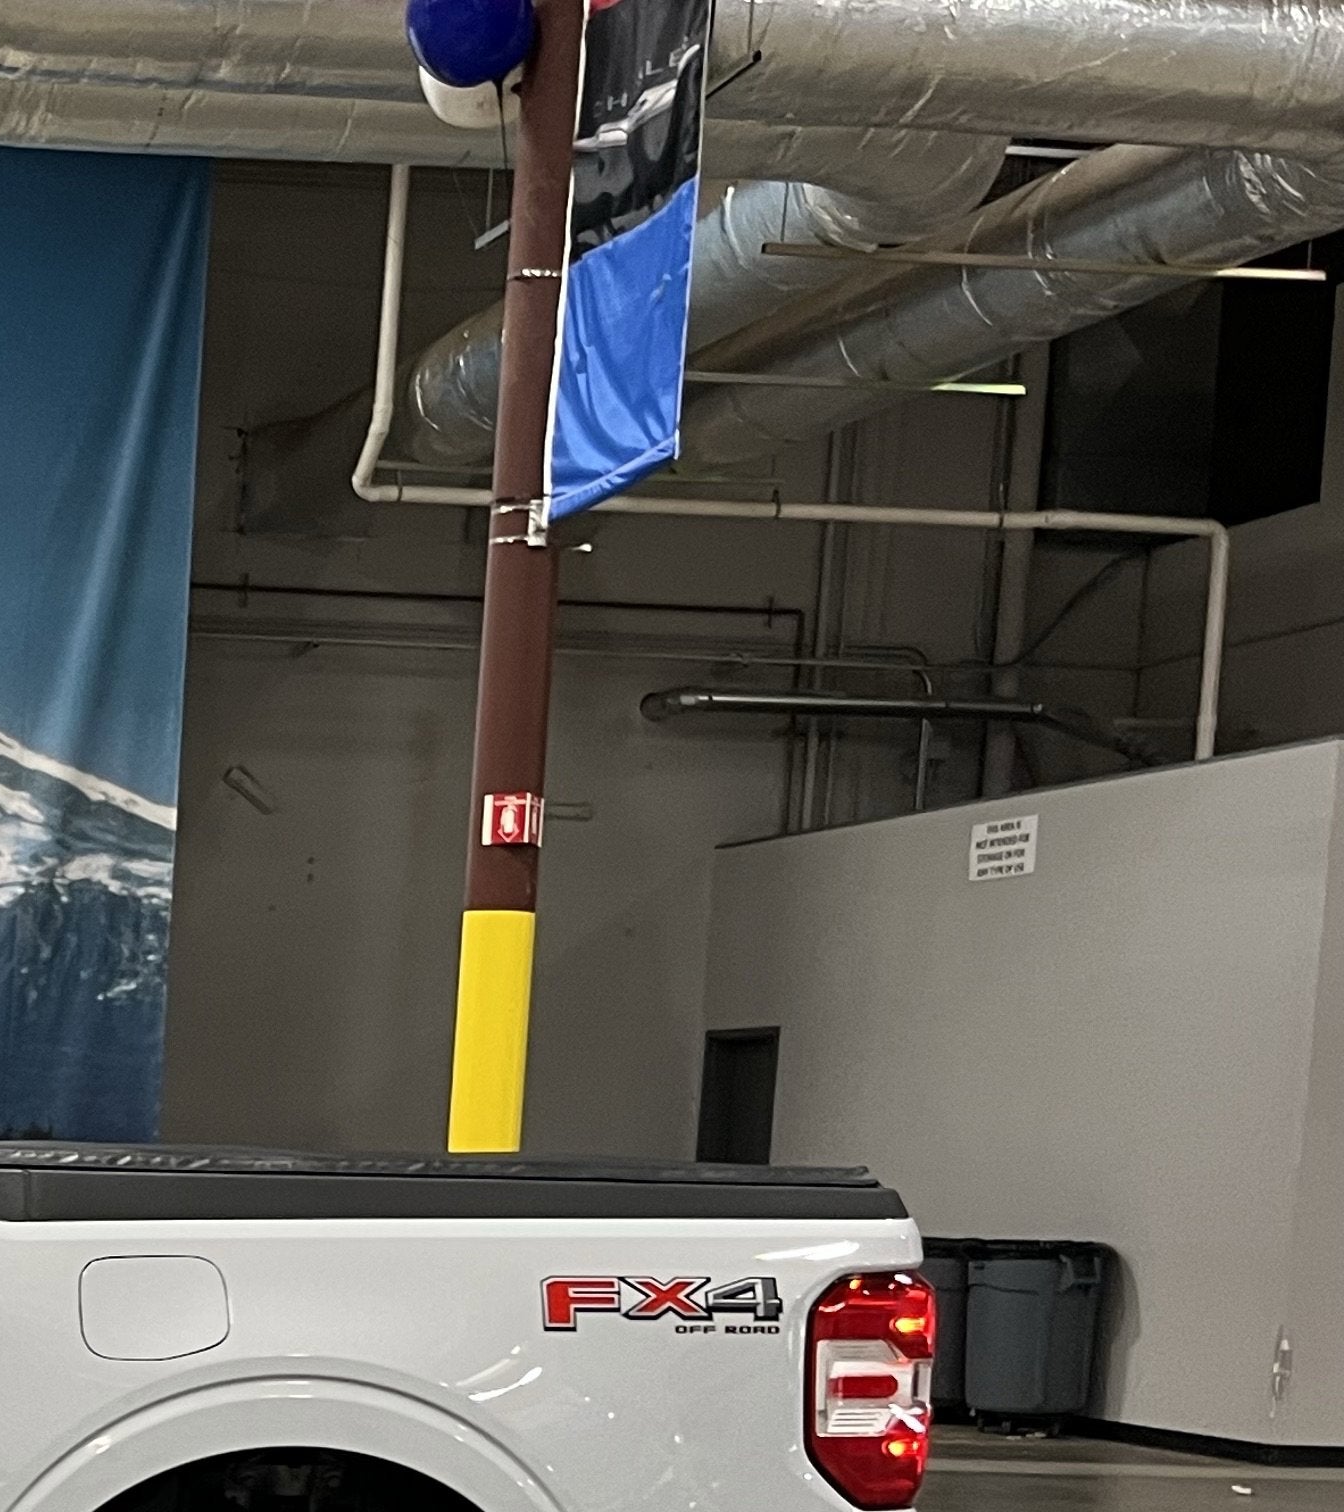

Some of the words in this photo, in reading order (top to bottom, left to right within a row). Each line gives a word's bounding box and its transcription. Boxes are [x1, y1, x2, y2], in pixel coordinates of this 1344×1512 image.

[541, 1275, 783, 1332] FX4
[675, 1325, 716, 1334] OFF
[724, 1325, 780, 1334] ROAD
